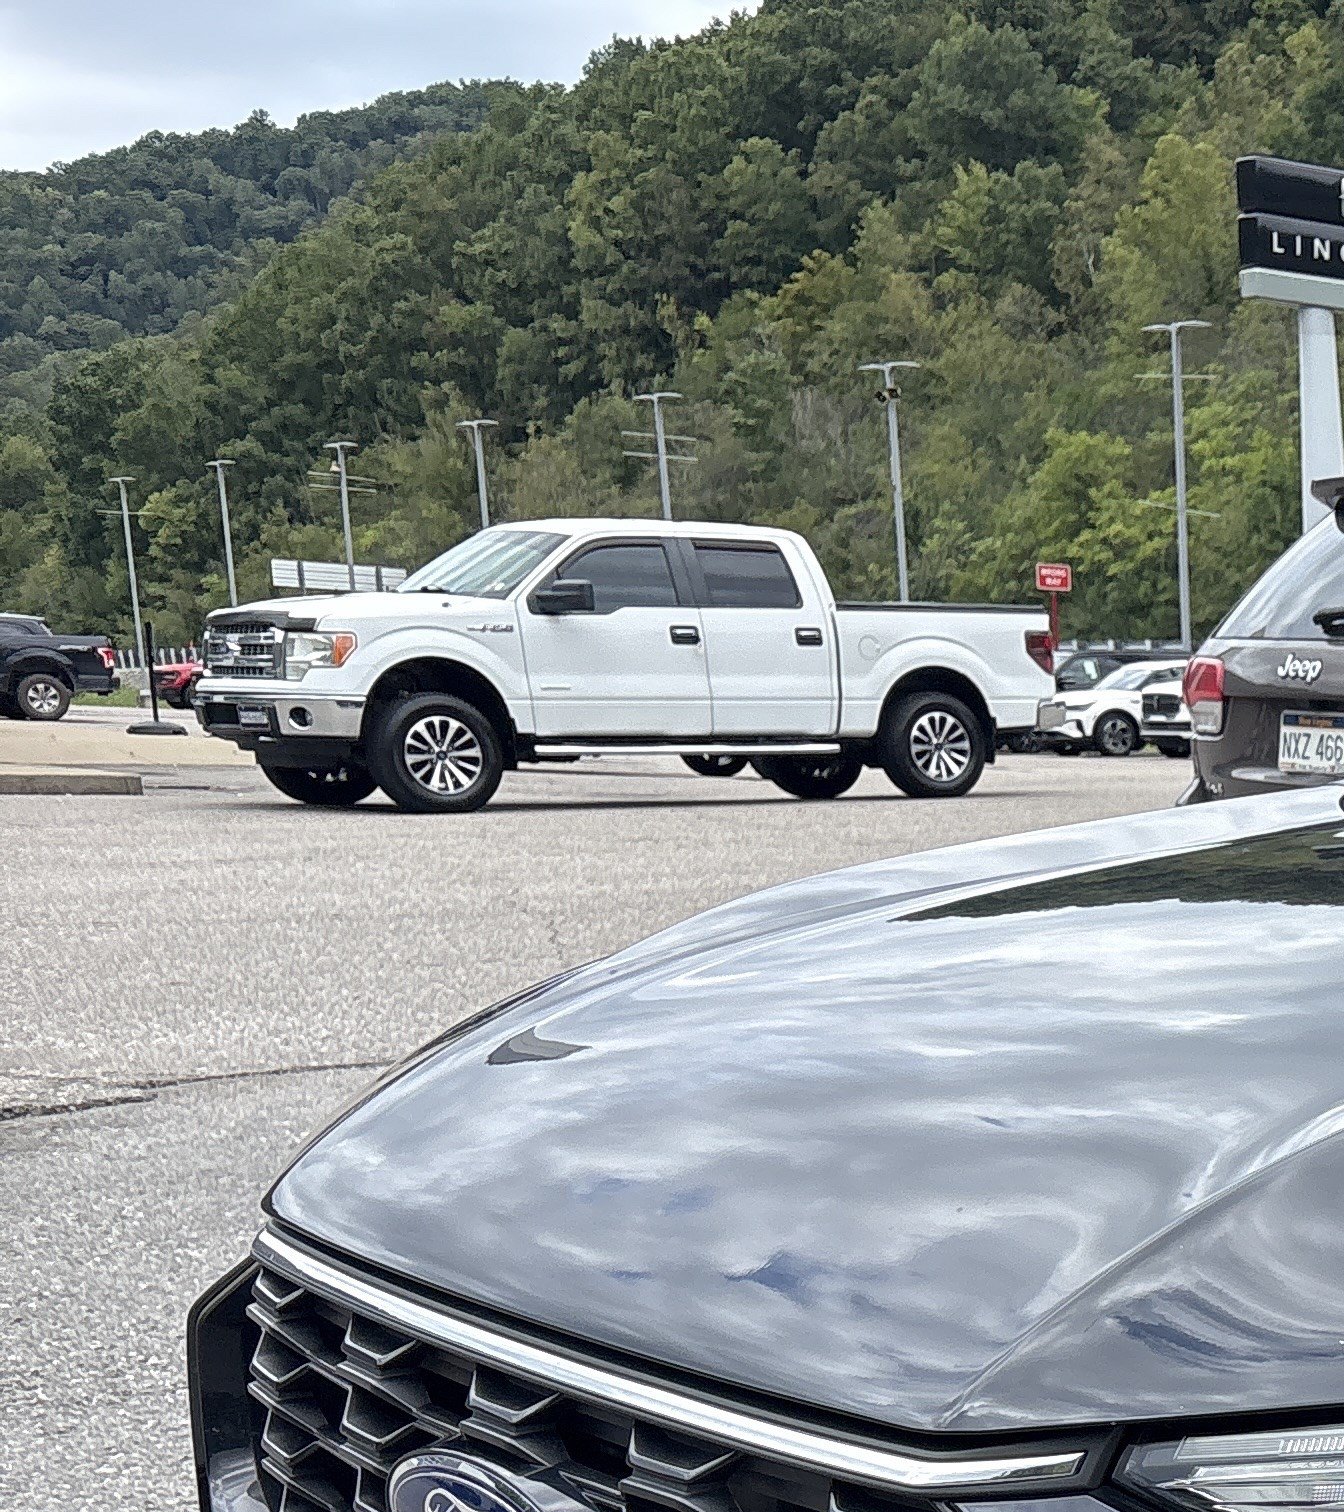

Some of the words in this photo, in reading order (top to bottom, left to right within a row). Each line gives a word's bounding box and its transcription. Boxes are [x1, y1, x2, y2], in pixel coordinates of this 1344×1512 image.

[1277, 653, 1322, 683] Jeep
[1281, 731, 1312, 760] NXZ
[1315, 733, 1344, 762] 466
